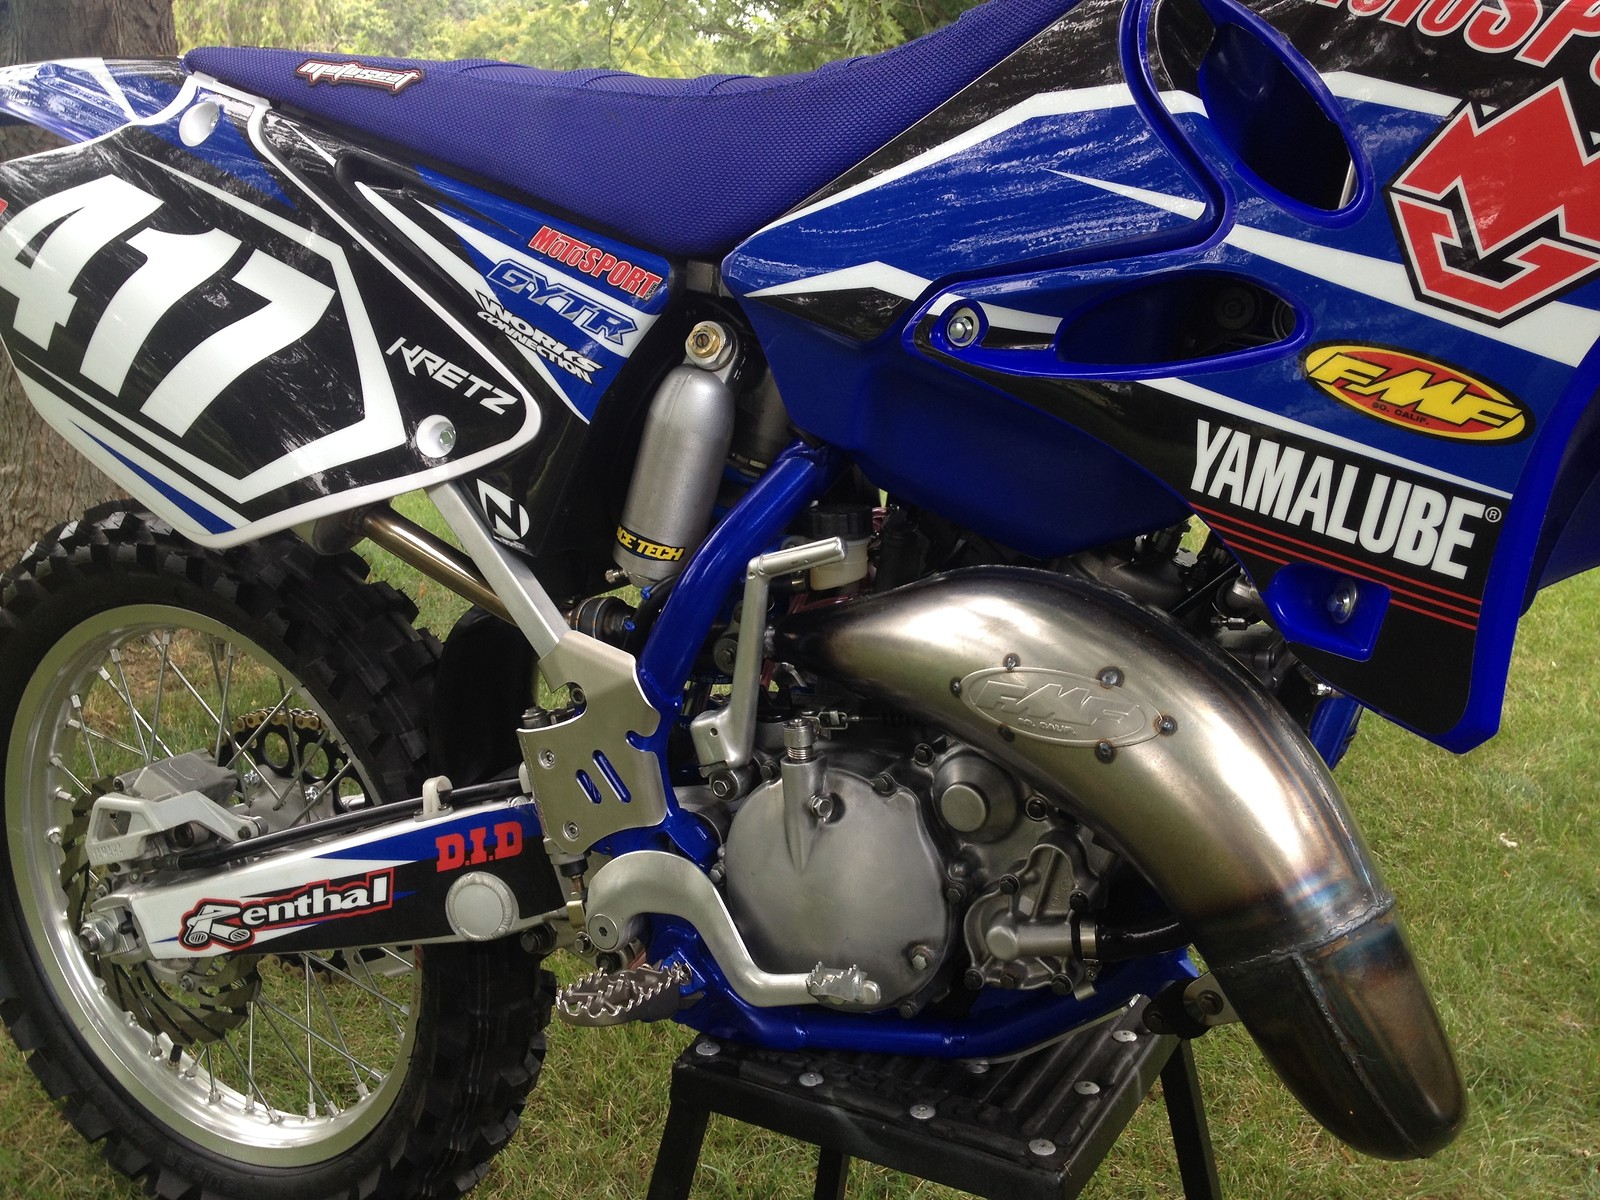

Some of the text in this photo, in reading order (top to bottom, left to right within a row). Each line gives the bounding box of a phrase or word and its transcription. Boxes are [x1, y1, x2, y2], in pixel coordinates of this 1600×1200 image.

[0, 174, 336, 438] 417
[476, 290, 606, 374] WORKS
[486, 259, 638, 345] GYTR
[385, 336, 519, 415] KRETZ
[477, 311, 594, 385] CONNECTION
[1308, 352, 1523, 429] FMF
[1394, 409, 1429, 425] CALIF.
[636, 540, 684, 561] TECH
[974, 680, 1137, 727] FMF
[436, 820, 523, 872] D.I.D
[183, 875, 388, 945] Renthal
